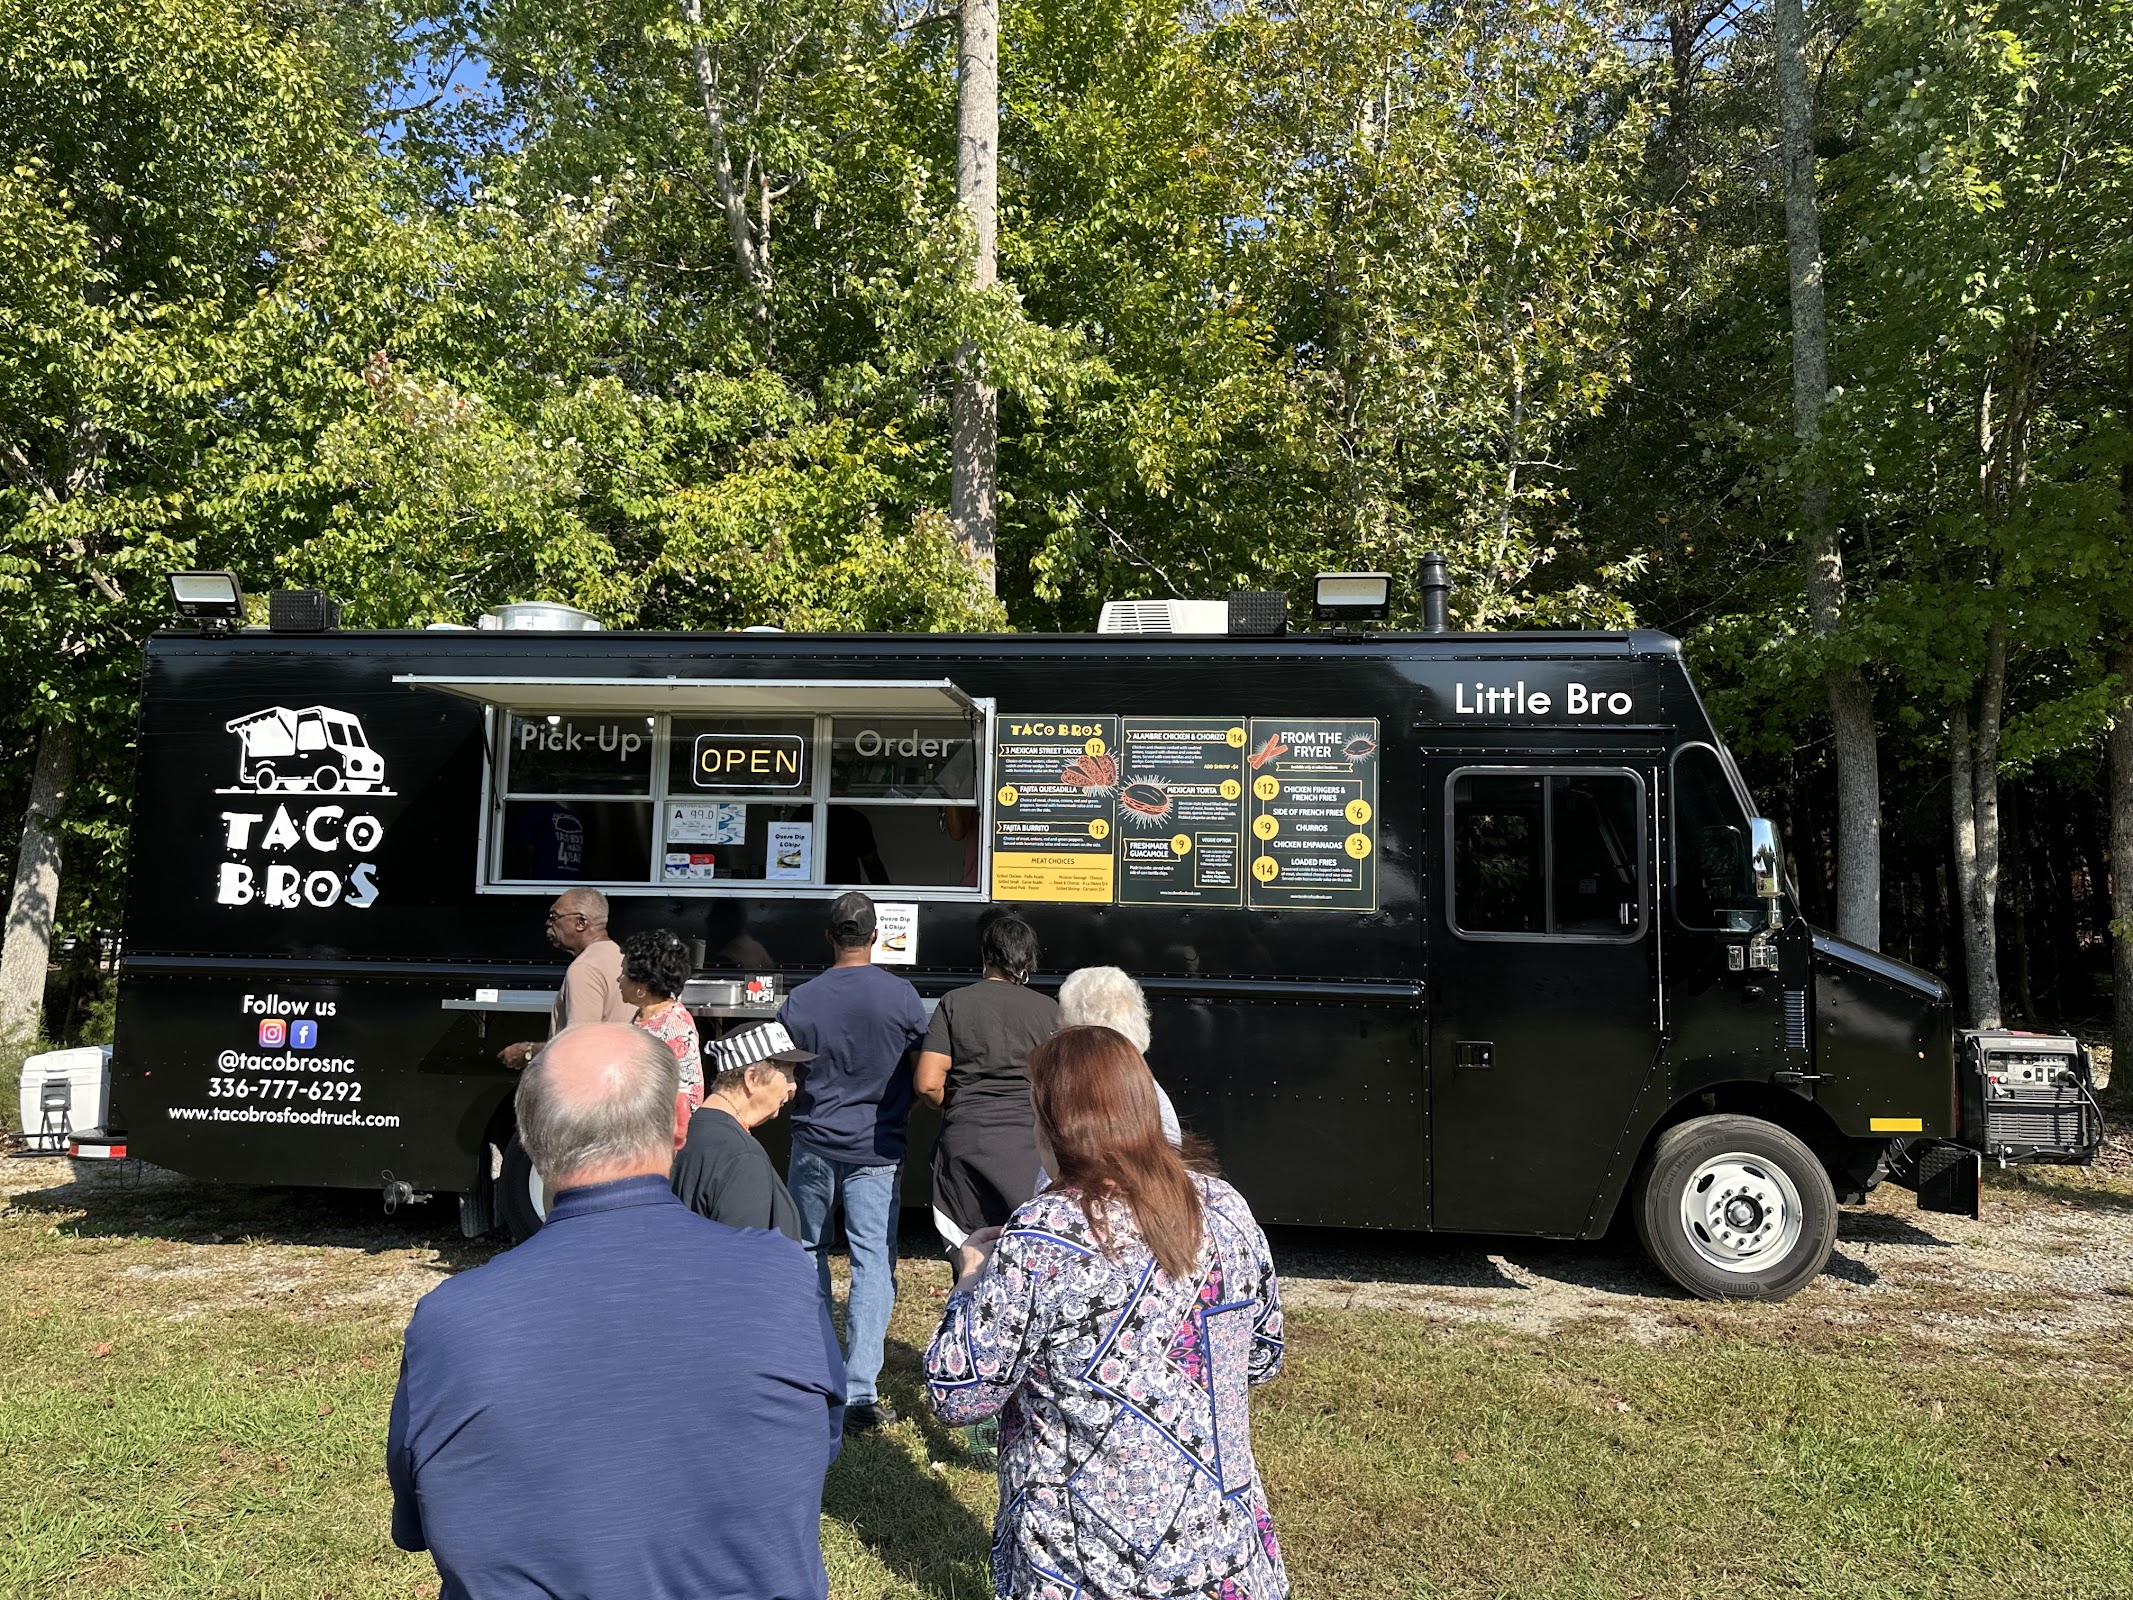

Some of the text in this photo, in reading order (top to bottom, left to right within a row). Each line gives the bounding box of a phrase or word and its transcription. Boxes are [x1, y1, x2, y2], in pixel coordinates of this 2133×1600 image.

[1456, 681, 1633, 715] Little Bro
[1010, 723, 1103, 736] TACO BROS
[520, 723, 642, 762] Pick-Up
[854, 728, 955, 758] Order
[1230, 733, 1243, 743] $14
[1281, 732, 1342, 744] FROM THE
[1088, 744, 1101, 753] $12
[1294, 746, 1331, 757] FRYER
[700, 748, 798, 774] OPEN
[1223, 785, 1236, 795] $13
[1257, 783, 1273, 794] $12
[1001, 791, 1013, 801] $12
[674, 810, 683, 819] A
[1352, 807, 1363, 818] $6
[222, 803, 383, 853] TACO
[1003, 824, 1021, 832] FAJITA
[1091, 825, 1105, 834] $12
[1260, 822, 1271, 833] $9
[1176, 839, 1184, 848] $9
[1303, 841, 1342, 849] EMPANADAS
[1352, 838, 1363, 850] $3
[1291, 858, 1318, 866] LOADED
[1256, 863, 1273, 875] $14
[216, 862, 380, 909] BROS
[756, 976, 773, 988] WE
[243, 994, 336, 1016] Follow us
[217, 1049, 355, 1074] @tacobrosnc
[208, 1078, 362, 1102] 336-777-6292
[168, 1104, 400, 1127] www.tacobrosfoodtruck.com
